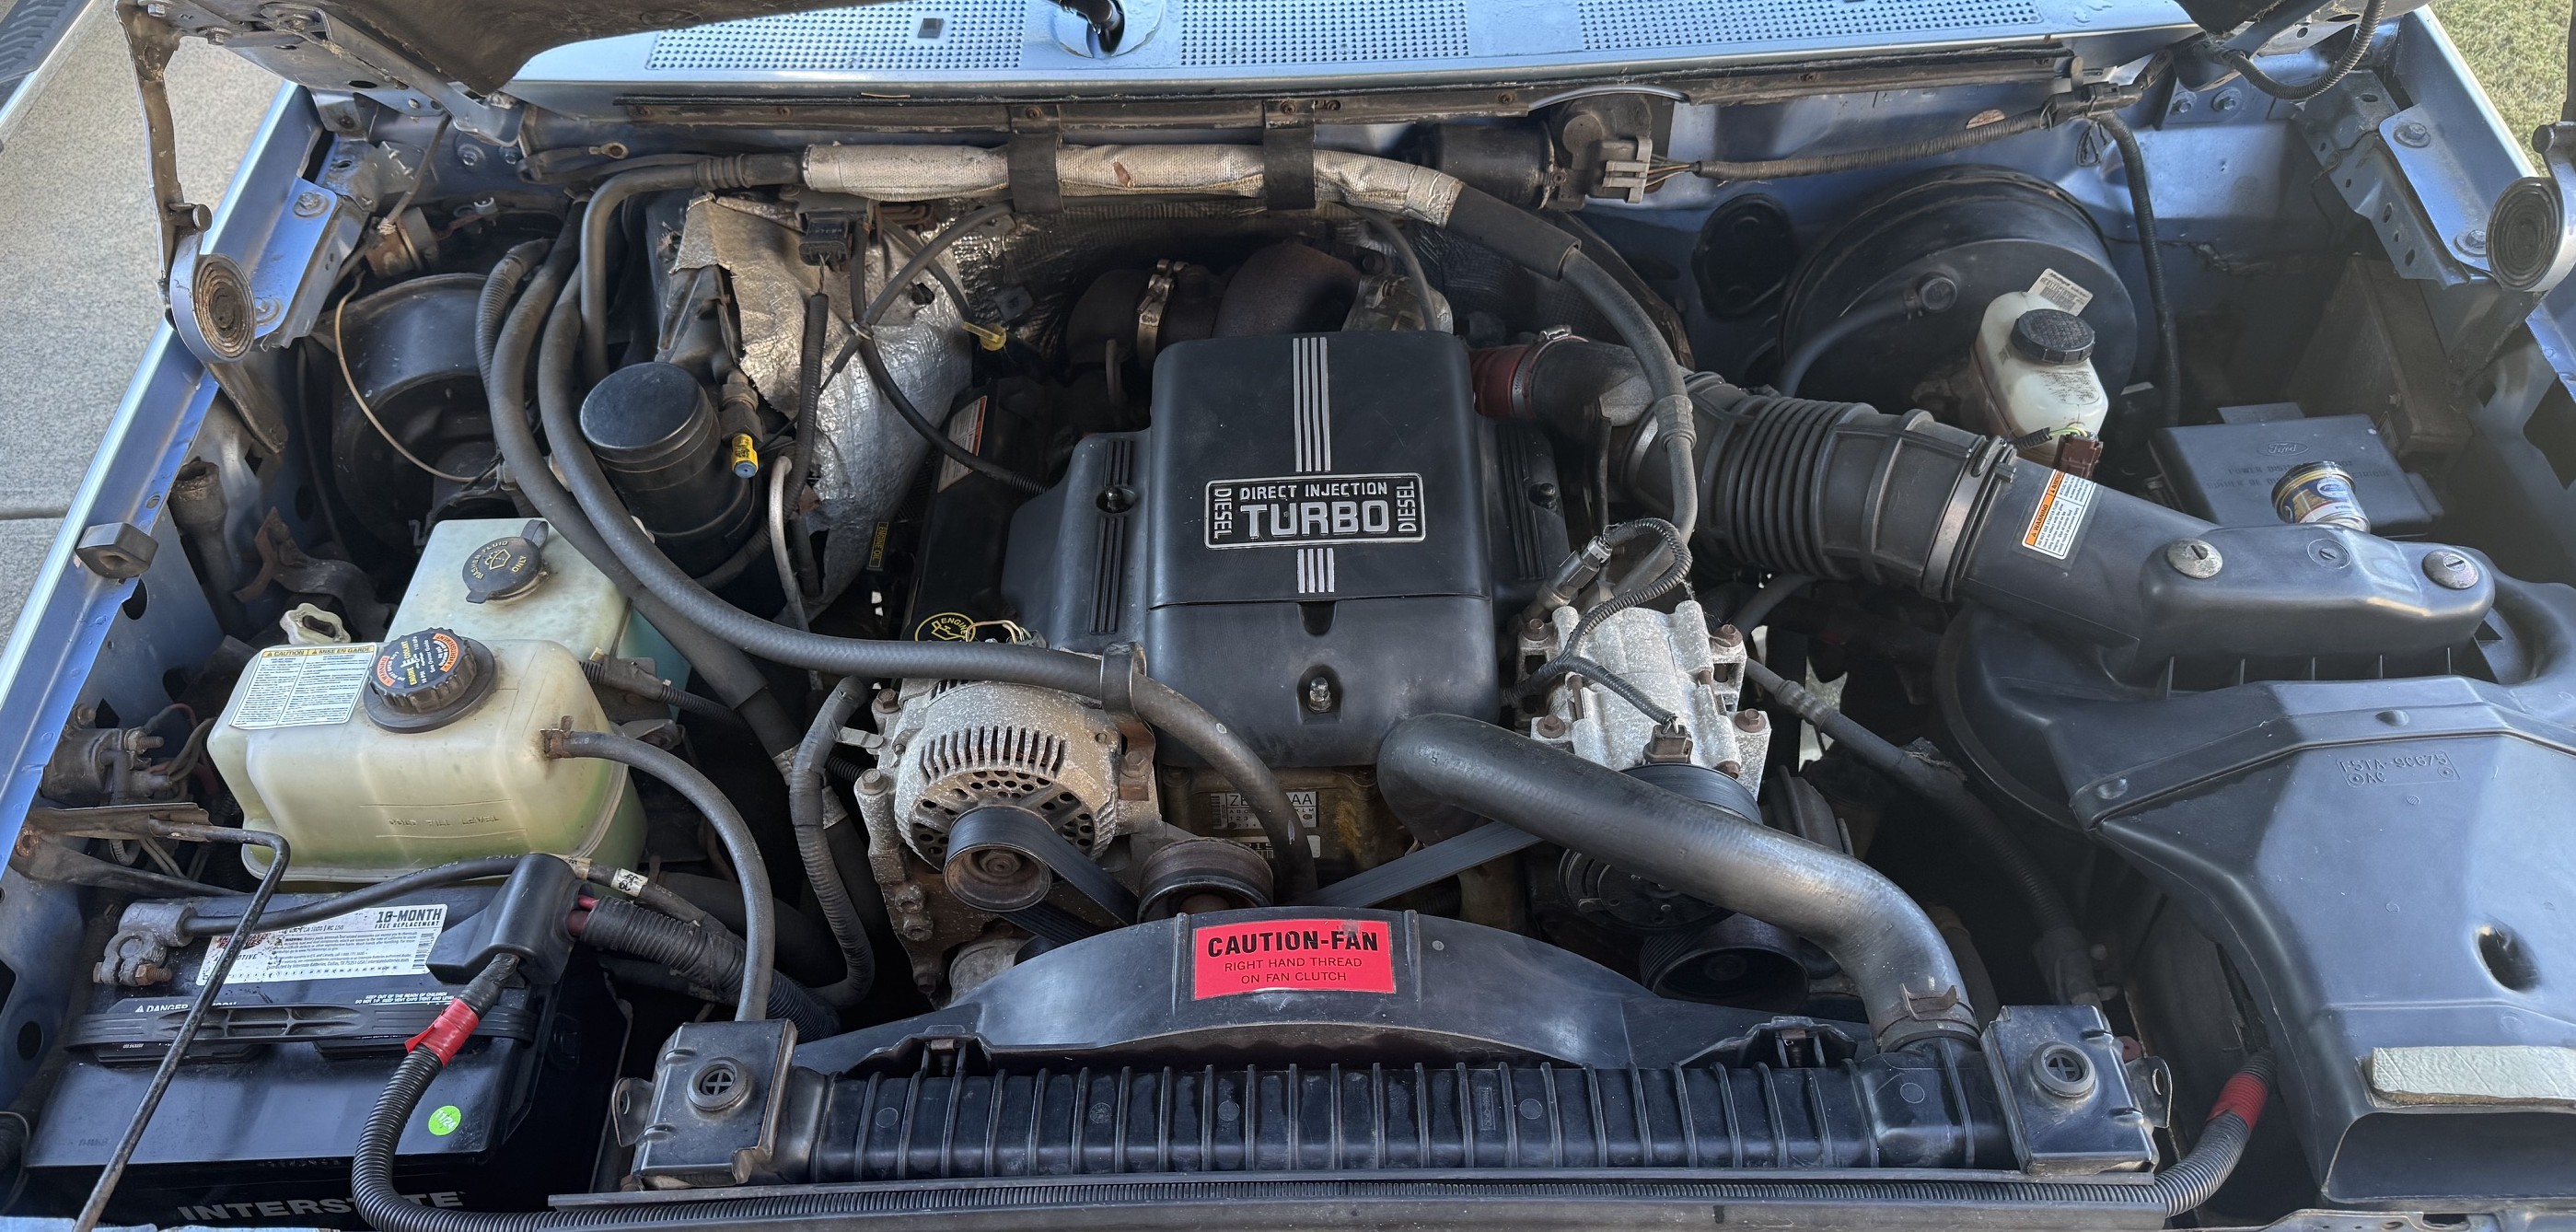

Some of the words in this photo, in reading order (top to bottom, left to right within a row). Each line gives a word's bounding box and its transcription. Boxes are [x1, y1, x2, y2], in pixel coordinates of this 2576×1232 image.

[2268, 443, 2297, 454] Ford
[1239, 485, 1296, 500] DIRECT
[1305, 482, 1387, 497] INJECTION
[1213, 487, 1233, 540] DIESEL
[1396, 481, 1417, 532] DIESEL
[1240, 500, 1390, 539] TURBO
[2033, 504, 2048, 531] WARNING
[875, 526, 886, 550] ENGINE
[470, 554, 484, 579] WASHER
[482, 540, 508, 552] FLUID
[511, 555, 527, 573] ONLY
[872, 549, 881, 561] OIL
[941, 617, 968, 635] ENGINE
[401, 641, 412, 659] COOLANT
[407, 667, 418, 686] ENGINE
[2367, 772, 2386, 784] AC
[462, 815, 500, 825] LEVEL
[1208, 930, 1378, 958] CAUTION-FAN
[1224, 959, 1263, 971] RIGHT
[1269, 958, 1305, 968] HAND
[1310, 957, 1363, 967] THREAD
[1241, 974, 1259, 984] ON
[1266, 972, 1290, 982] FAN
[1294, 971, 1347, 982] CLUTCH
[177, 1191, 464, 1222] INTERSTE
